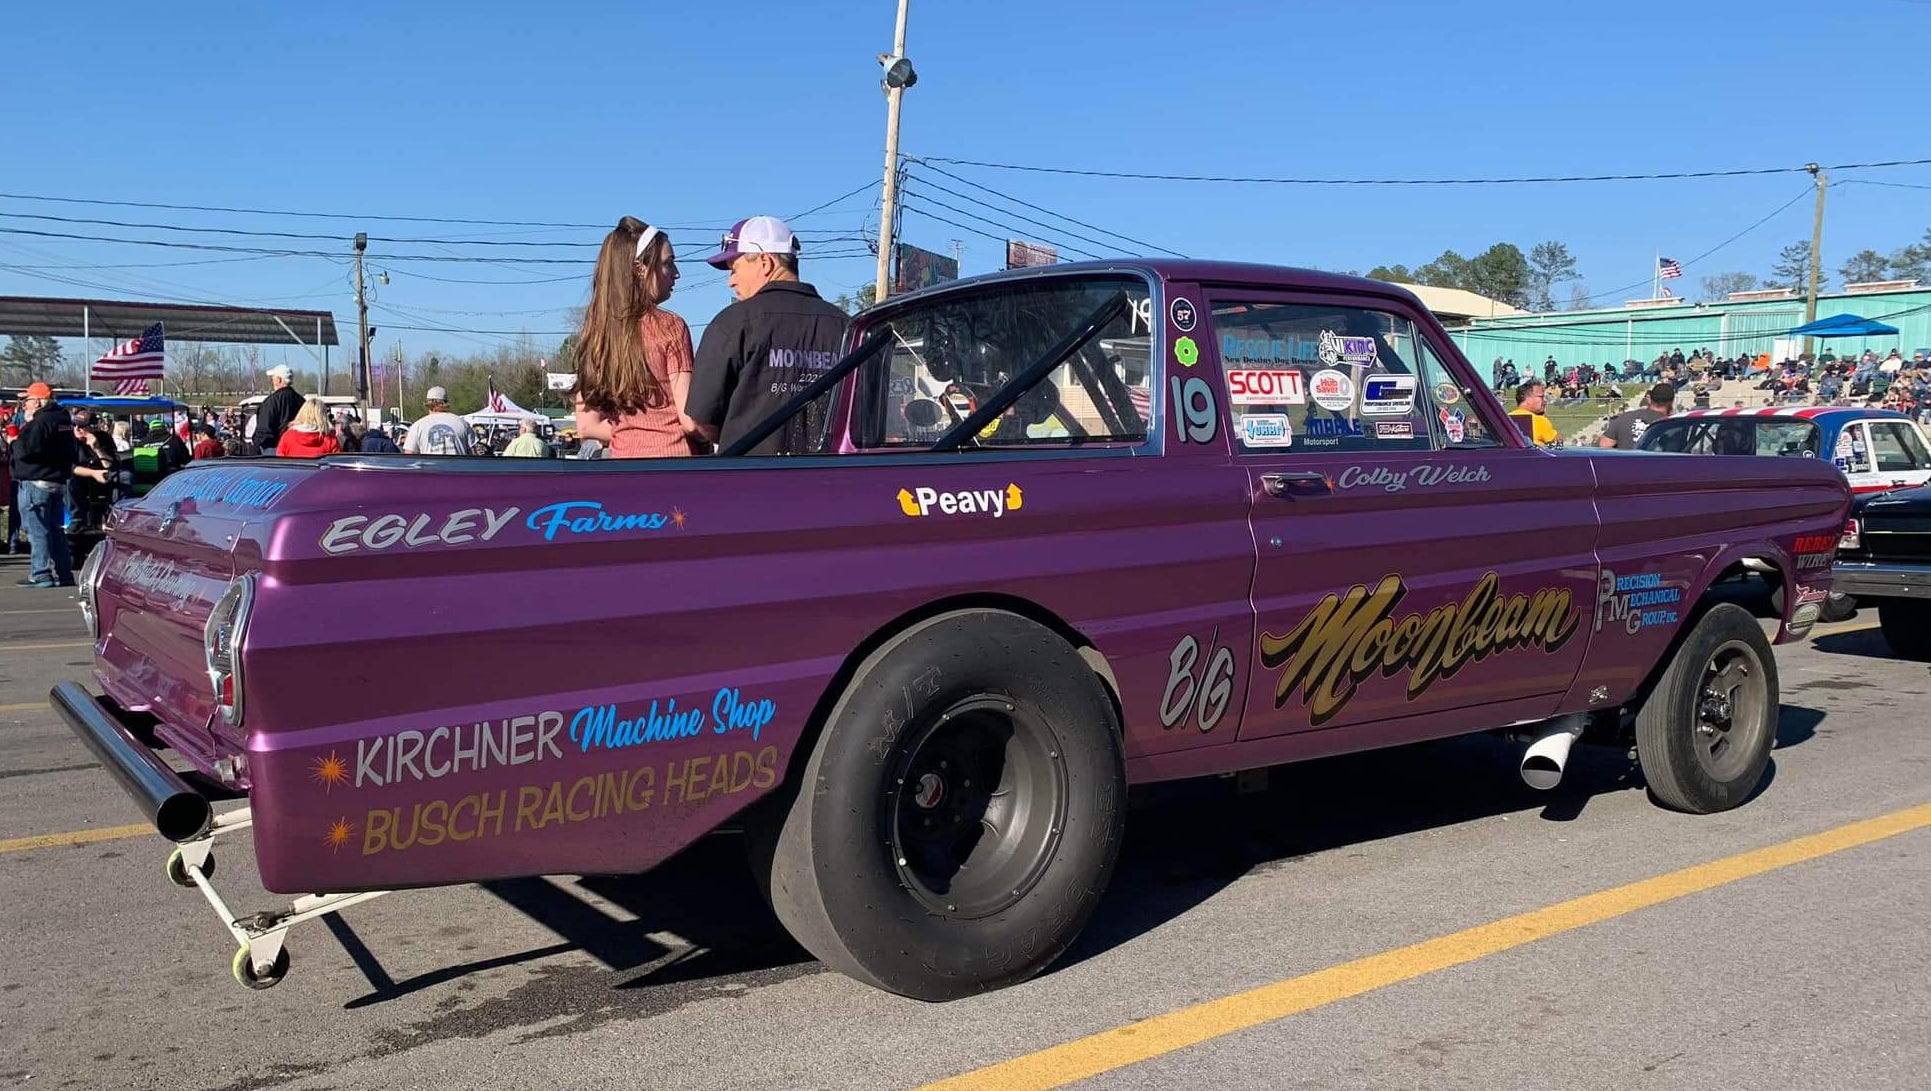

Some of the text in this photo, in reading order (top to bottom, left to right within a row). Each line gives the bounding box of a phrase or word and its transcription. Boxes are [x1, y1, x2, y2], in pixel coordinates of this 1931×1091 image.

[1177, 309, 1191, 321] 57
[1331, 338, 1374, 354] VIKING
[769, 349, 842, 370] MOONBEA
[1243, 355, 1271, 364] Destiny
[1275, 356, 1289, 364] Dog
[770, 383, 788, 395] B/G
[1229, 372, 1300, 395] SCOTT
[1316, 386, 1338, 394] Saver
[1321, 377, 1338, 386] Hub
[1171, 375, 1217, 444] 19
[1304, 438, 1339, 446] Motorsport
[1339, 465, 1491, 492] Colby Welch
[916, 487, 1004, 518] Peavy
[320, 501, 668, 556] EGLEY Farms
[1608, 588, 1680, 622] MECHANICAL
[1260, 571, 1581, 726] Moonbeam
[1159, 624, 1236, 734] B/G
[355, 687, 777, 788] KIRCHNER Machine Shop
[362, 746, 779, 856] BUSCH RACING HEADS
